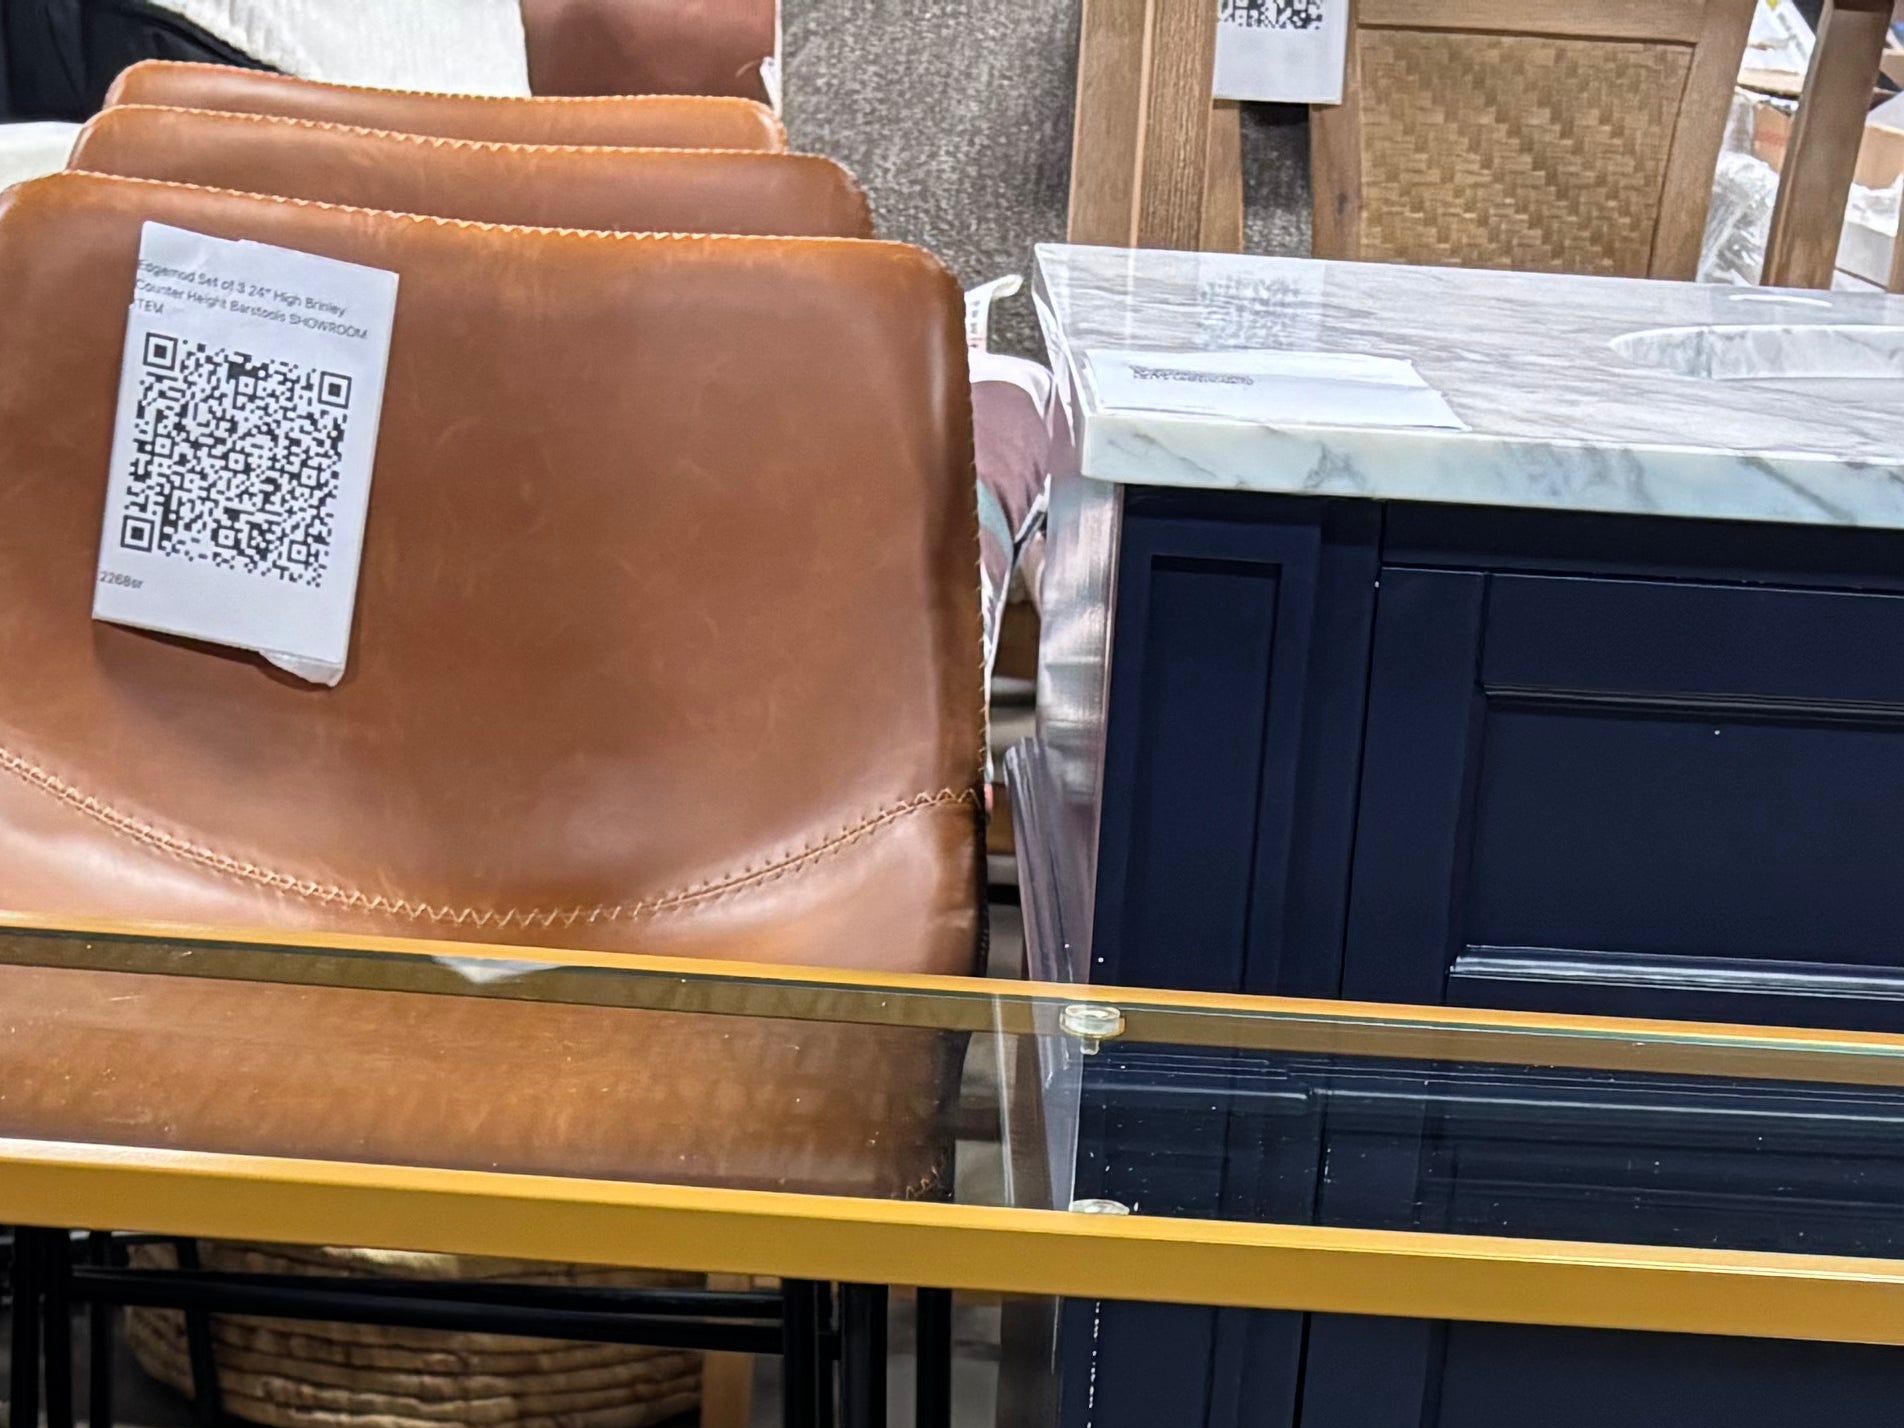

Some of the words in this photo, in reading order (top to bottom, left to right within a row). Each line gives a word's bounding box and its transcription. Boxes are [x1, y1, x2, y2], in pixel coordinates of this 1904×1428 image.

[137, 298, 164, 313] TEM
[198, 273, 218, 288] Set
[221, 280, 234, 292] of
[237, 282, 246, 294] 3
[273, 290, 302, 307] High
[136, 279, 185, 299] Counter
[187, 291, 227, 309] Height
[230, 300, 286, 322] Barstools
[289, 313, 368, 339] SHOWROOM
